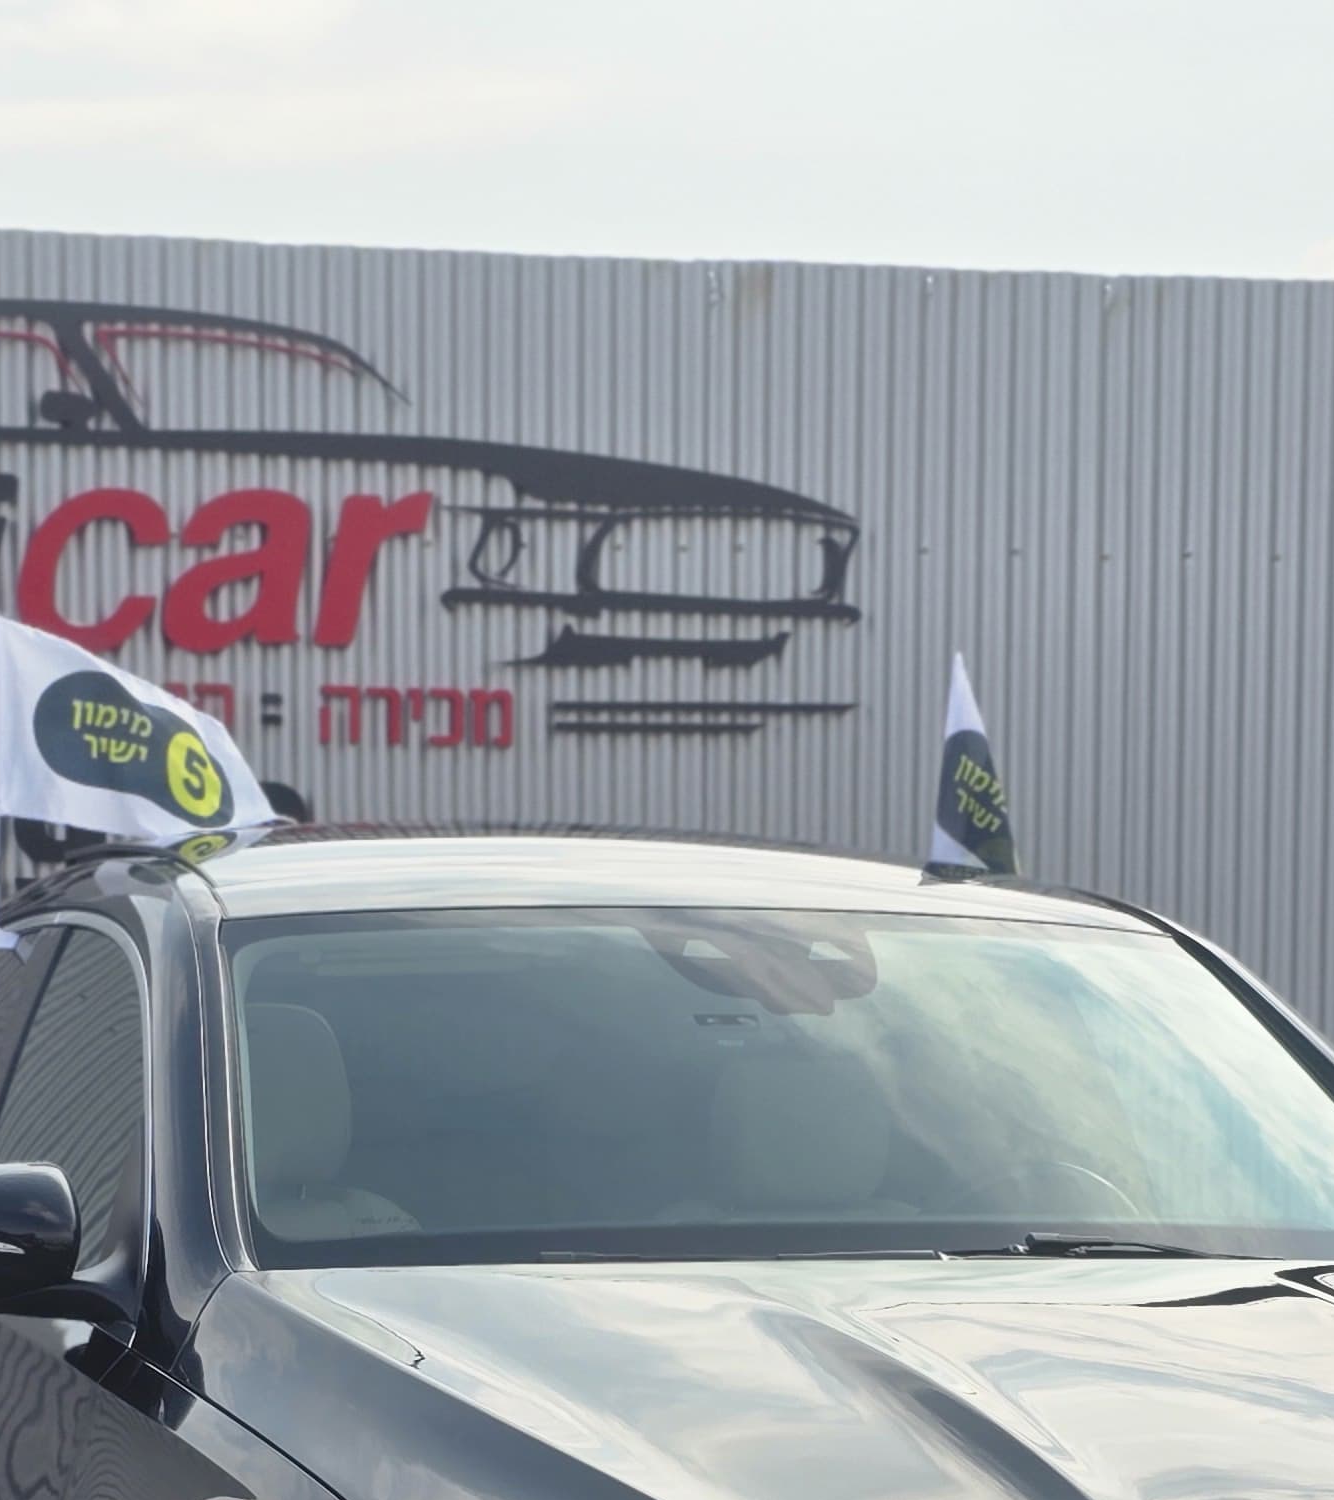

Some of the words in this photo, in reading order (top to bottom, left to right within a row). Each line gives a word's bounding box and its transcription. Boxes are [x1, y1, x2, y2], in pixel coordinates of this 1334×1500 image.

[72, 698, 154, 738] מימון
[319, 684, 514, 749] מכירה
[83, 733, 149, 764] ישיר
[957, 787, 1002, 833] ישיר
